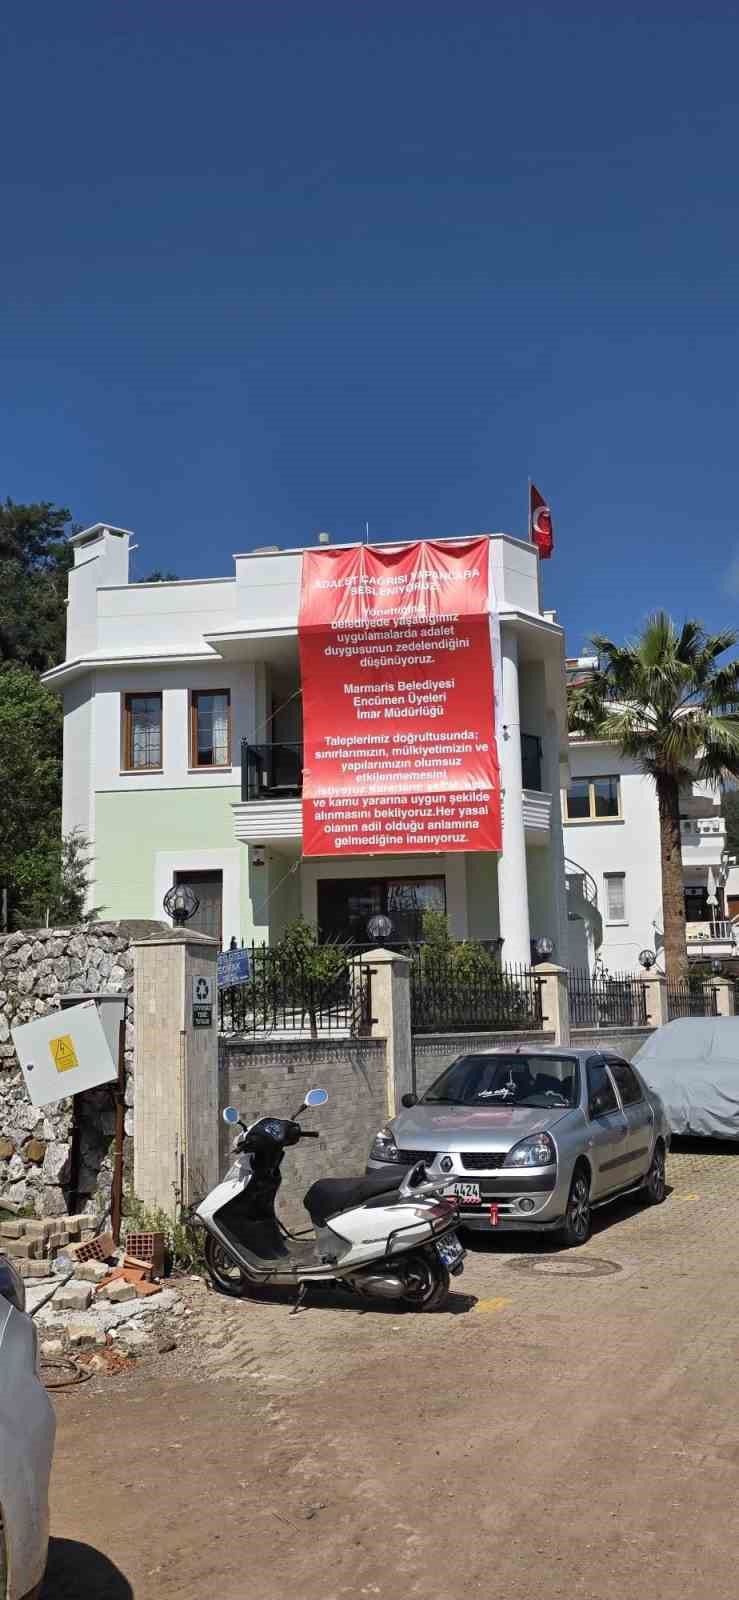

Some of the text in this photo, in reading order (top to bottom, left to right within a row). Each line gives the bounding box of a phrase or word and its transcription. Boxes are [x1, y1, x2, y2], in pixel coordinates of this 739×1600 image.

[331, 616, 389, 630] belediyede
[336, 627, 455, 644] uygulamalarda adalet
[323, 638, 470, 657] duygusunun zedelendiğini
[359, 655, 436, 669] düşünüyoruz.
[343, 678, 456, 695] Marmaris Belediyesi
[352, 692, 448, 708] Encümen Üyeleri
[356, 704, 445, 720] İmar Müdürlüğü
[323, 735, 392, 748] Taleplerimiz
[314, 744, 489, 761] sınırlarımızın, mülkiyetimizin ve
[341, 758, 463, 773] yapılarımızın olumsuz
[355, 770, 449, 783] etkilenmemesini
[312, 791, 490, 809] ve kamu yararına uygun şekilde
[314, 805, 489, 822] alınmasını bekliyoruz.Her yasal
[323, 819, 480, 834] olanın adil olduğu anlamına
[334, 832, 469, 848] gelmediğine inanıyoruz.
[454, 1183, 480, 1197] 4424
